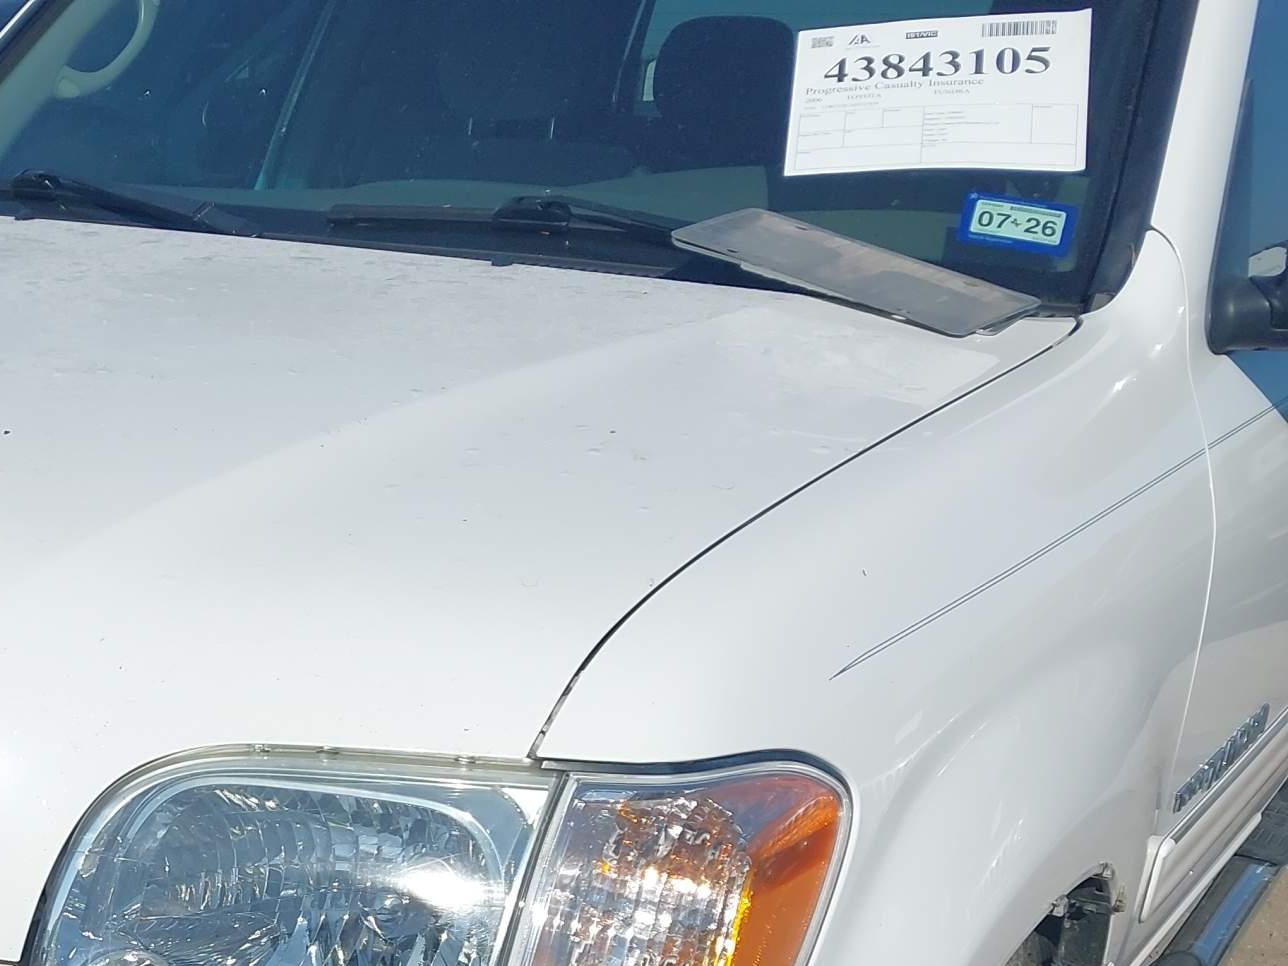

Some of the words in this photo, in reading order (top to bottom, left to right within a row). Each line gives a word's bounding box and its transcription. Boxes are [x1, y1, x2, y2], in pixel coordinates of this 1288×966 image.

[823, 46, 1052, 82] 43843105
[805, 83, 872, 96] Progressive
[875, 79, 923, 89] Casualty
[929, 78, 985, 87] Insurance
[978, 210, 1012, 229] 07
[1023, 217, 1058, 237] 26
